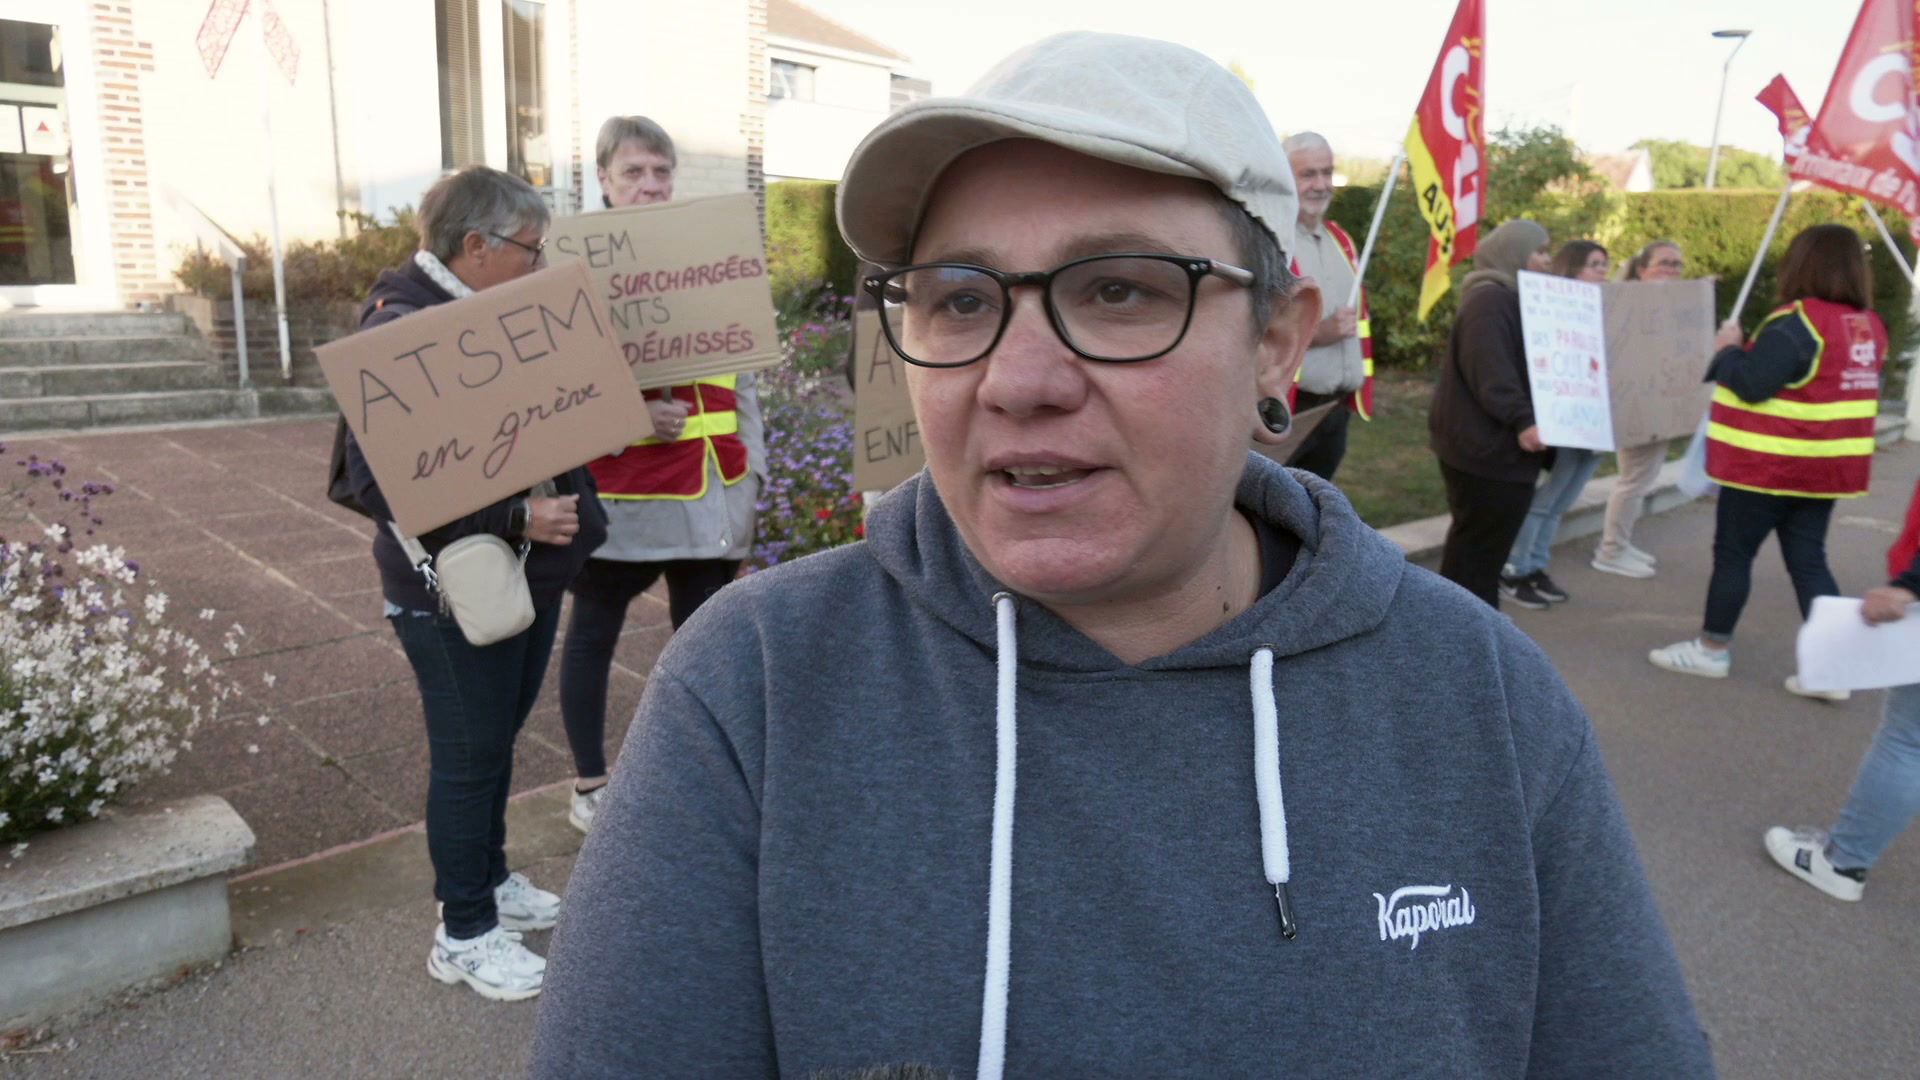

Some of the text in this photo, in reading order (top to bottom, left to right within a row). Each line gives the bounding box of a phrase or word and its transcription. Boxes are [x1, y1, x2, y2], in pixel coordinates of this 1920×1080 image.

[608, 255, 764, 300] SURCHARGÉES
[358, 288, 605, 434] ATSEM
[621, 323, 755, 367] DÉLAISSÉS
[412, 438, 474, 480] en
[483, 384, 602, 480] grève
[1373, 884, 1475, 950] Kaporal
